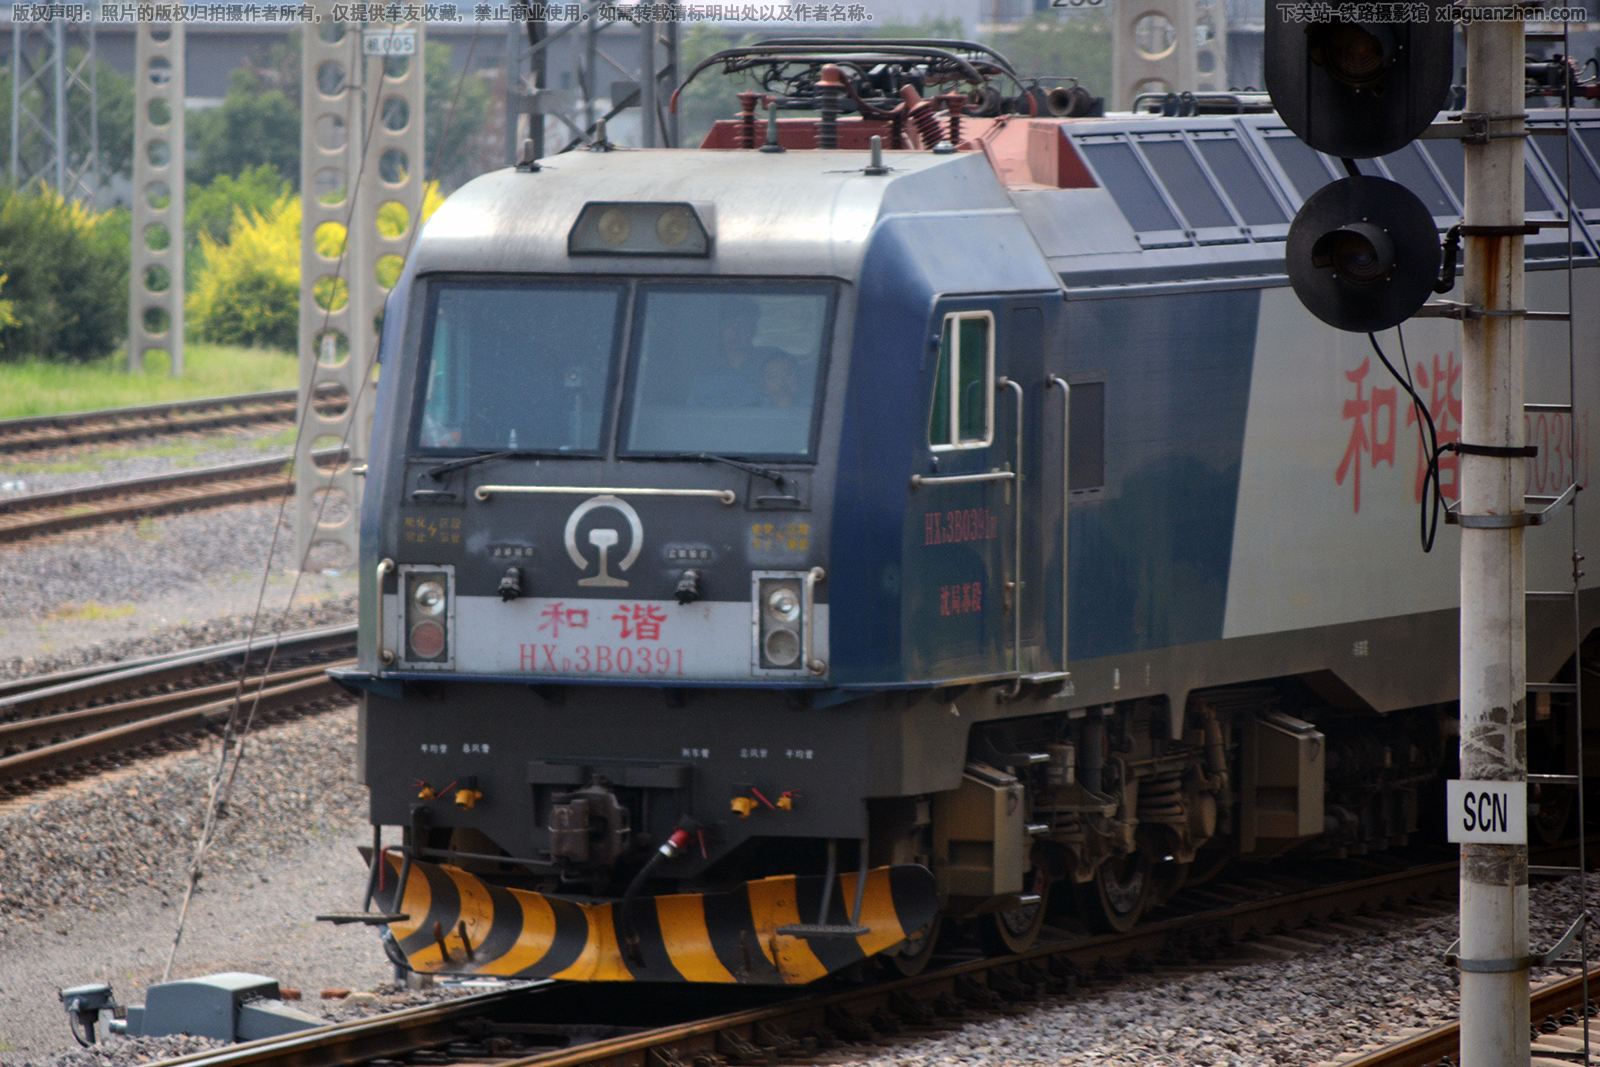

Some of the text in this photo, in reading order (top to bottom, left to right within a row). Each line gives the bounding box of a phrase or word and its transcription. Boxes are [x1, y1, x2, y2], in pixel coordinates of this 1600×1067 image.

[538, 602, 668, 641] 和谐
[519, 643, 686, 676] HXD3B0391
[1463, 791, 1508, 833] SCN
